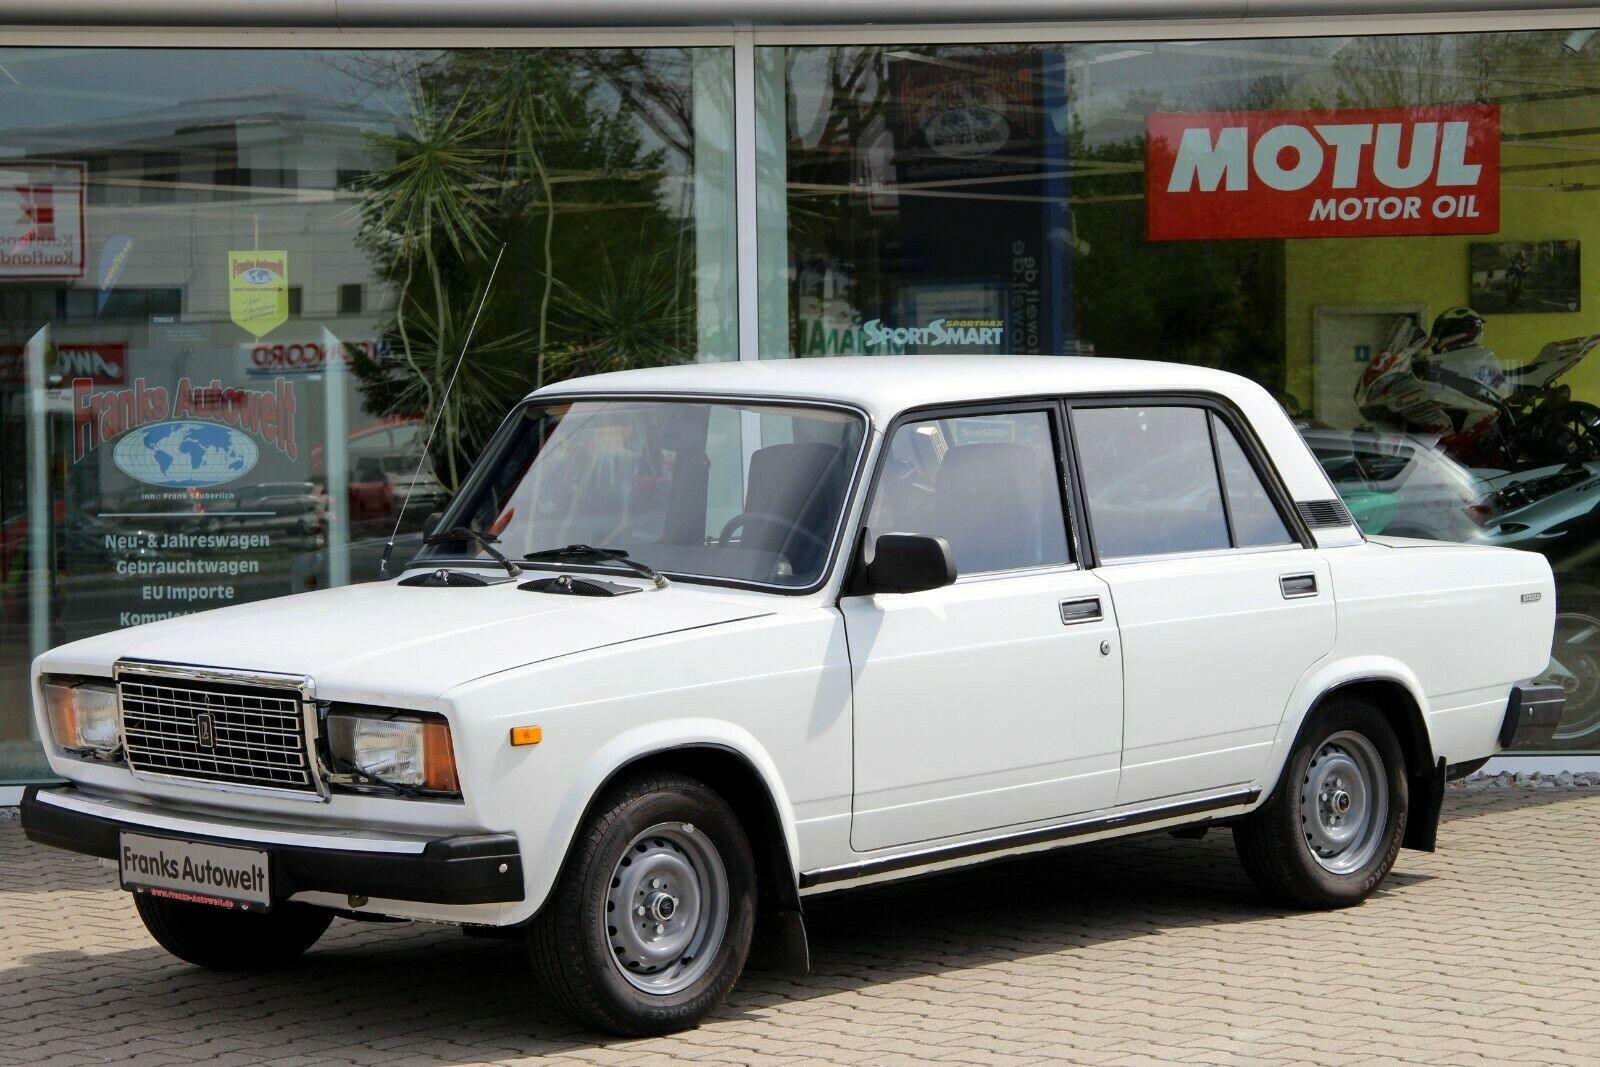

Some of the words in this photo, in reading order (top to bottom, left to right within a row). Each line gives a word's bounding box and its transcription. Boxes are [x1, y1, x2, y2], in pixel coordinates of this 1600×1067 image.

[1166, 121, 1483, 193] MOTUL
[1308, 197, 1421, 221] MOTOR
[1432, 195, 1480, 218] OIL
[72, 377, 170, 464] Franks
[172, 377, 298, 462] Autowelt
[163, 492, 187, 500] Frank
[105, 534, 144, 549] Neu-
[147, 534, 158, 549] &
[160, 534, 270, 550] Jahreswagen
[116, 560, 260, 575] Gebrauchtwagen
[142, 586, 164, 600] EU
[166, 585, 235, 602] Importe
[123, 846, 179, 879] Franks
[182, 855, 265, 892] Autowelt
